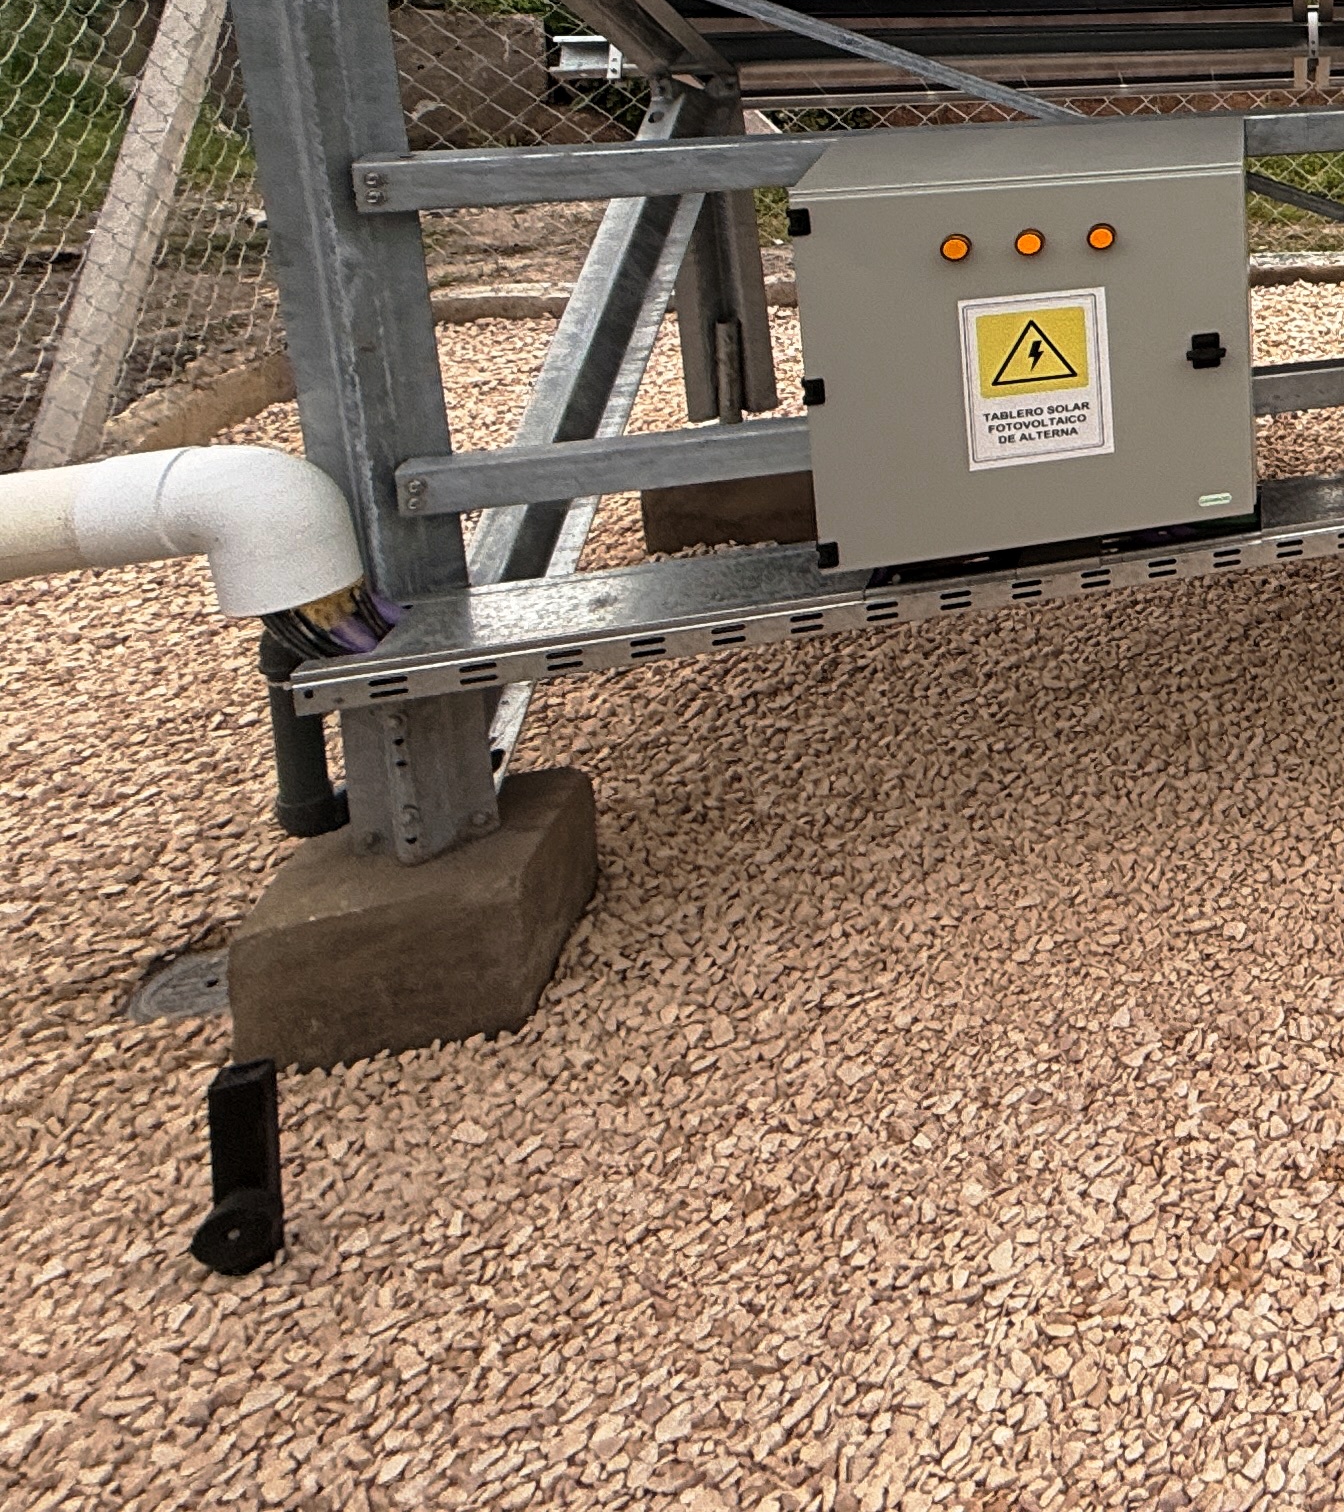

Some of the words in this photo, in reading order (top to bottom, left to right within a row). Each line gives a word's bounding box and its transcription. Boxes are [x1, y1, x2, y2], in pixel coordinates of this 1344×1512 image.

[983, 407, 1044, 422] TABLERO
[1047, 401, 1090, 414] SOLAR
[988, 413, 1087, 433] FOTOVOLTAICO
[998, 434, 1015, 444] DE
[1019, 426, 1078, 442] ALTERNA
